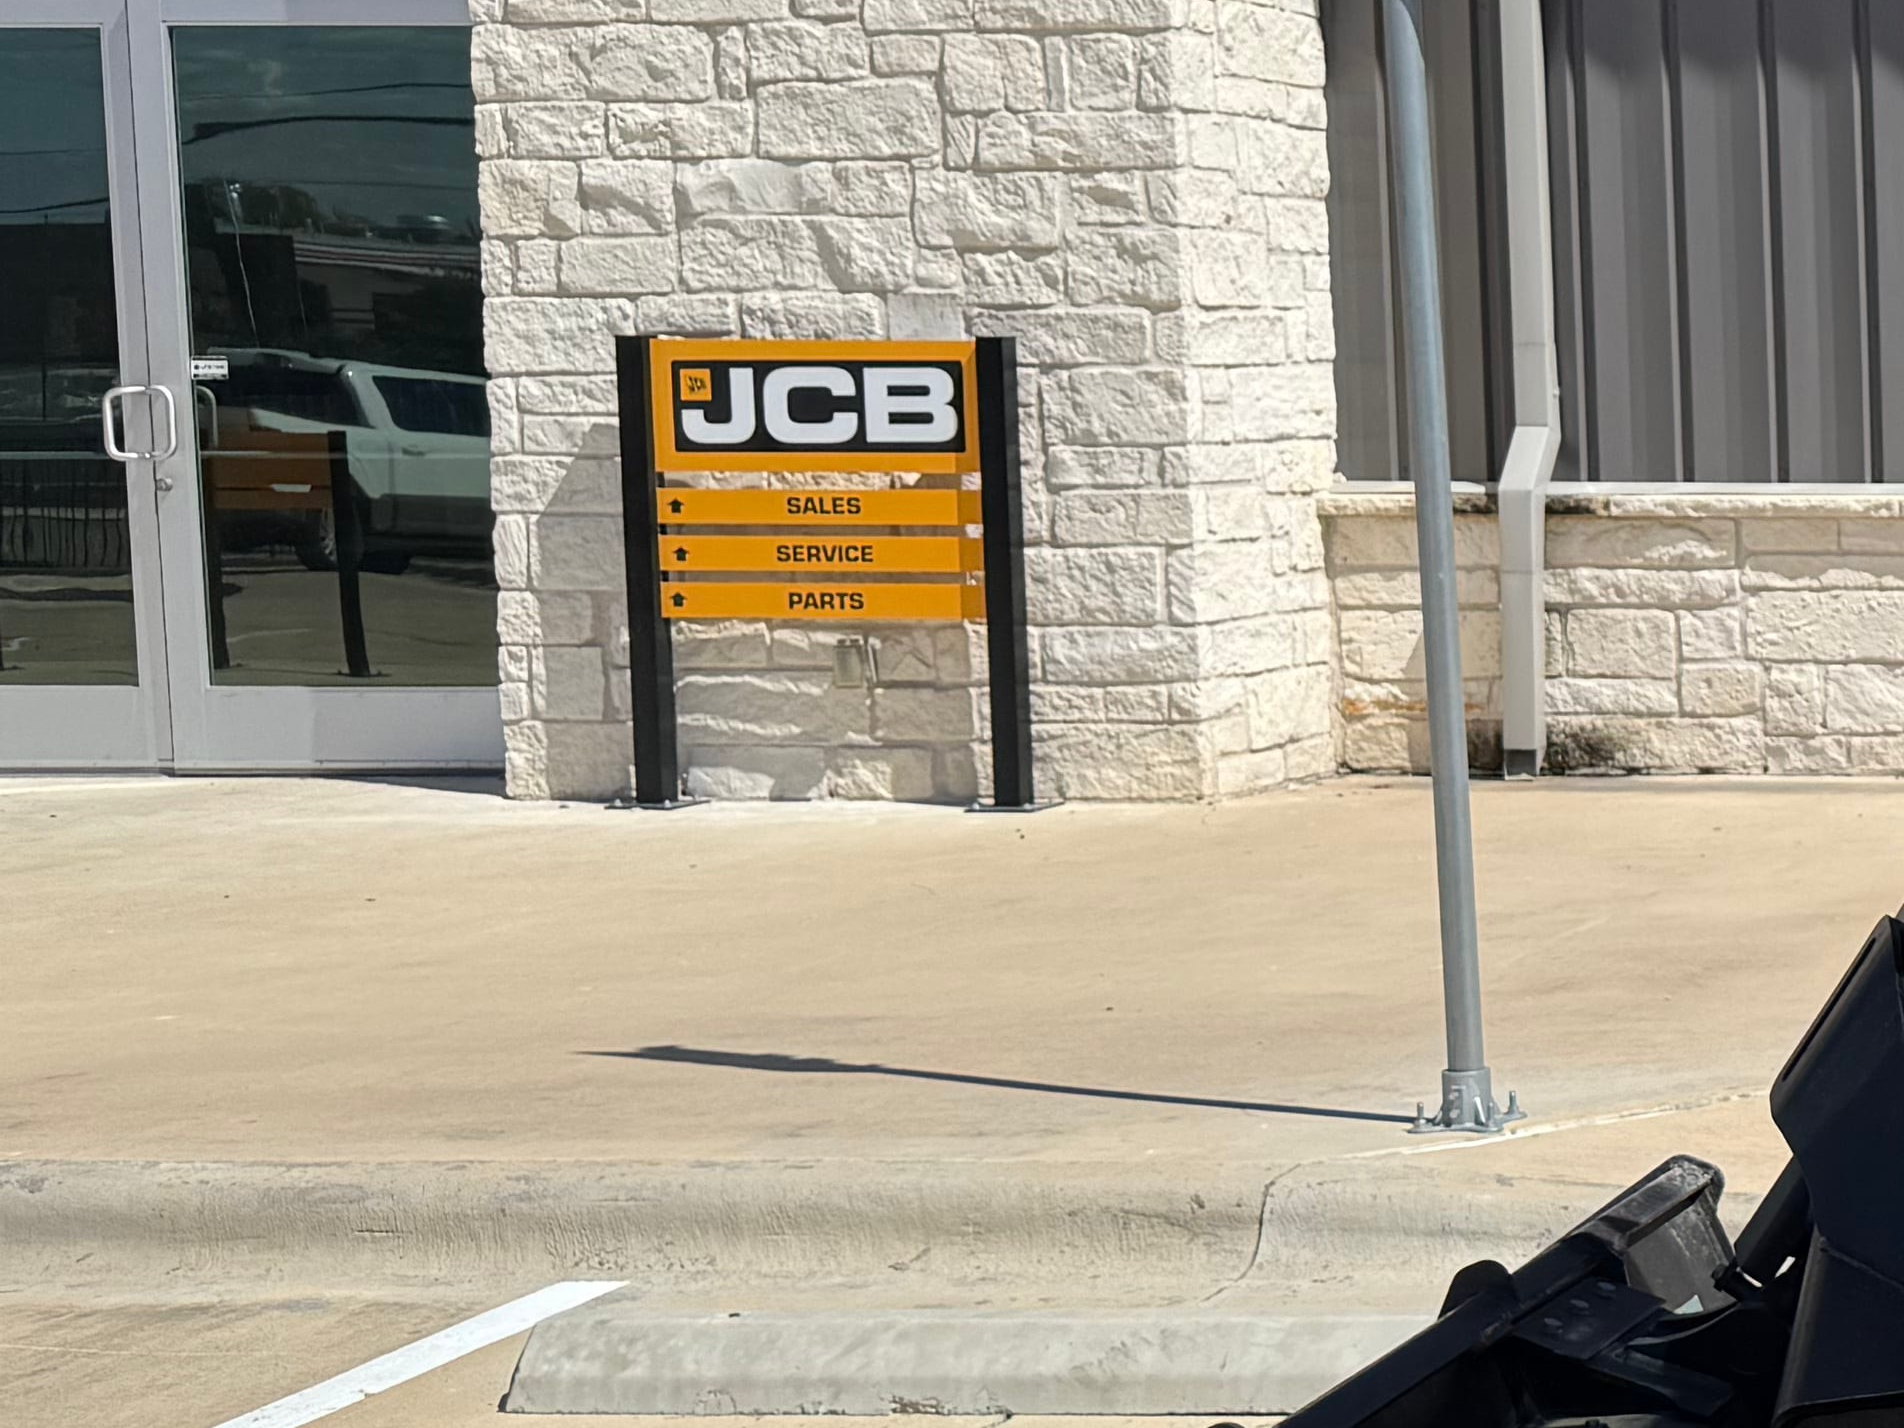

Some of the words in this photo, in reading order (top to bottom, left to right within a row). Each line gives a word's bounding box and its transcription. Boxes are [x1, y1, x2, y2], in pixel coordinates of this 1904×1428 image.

[681, 366, 959, 444] JCB
[786, 497, 862, 515] SALES
[776, 544, 875, 563] SERVICE
[788, 592, 865, 610] PARTS
